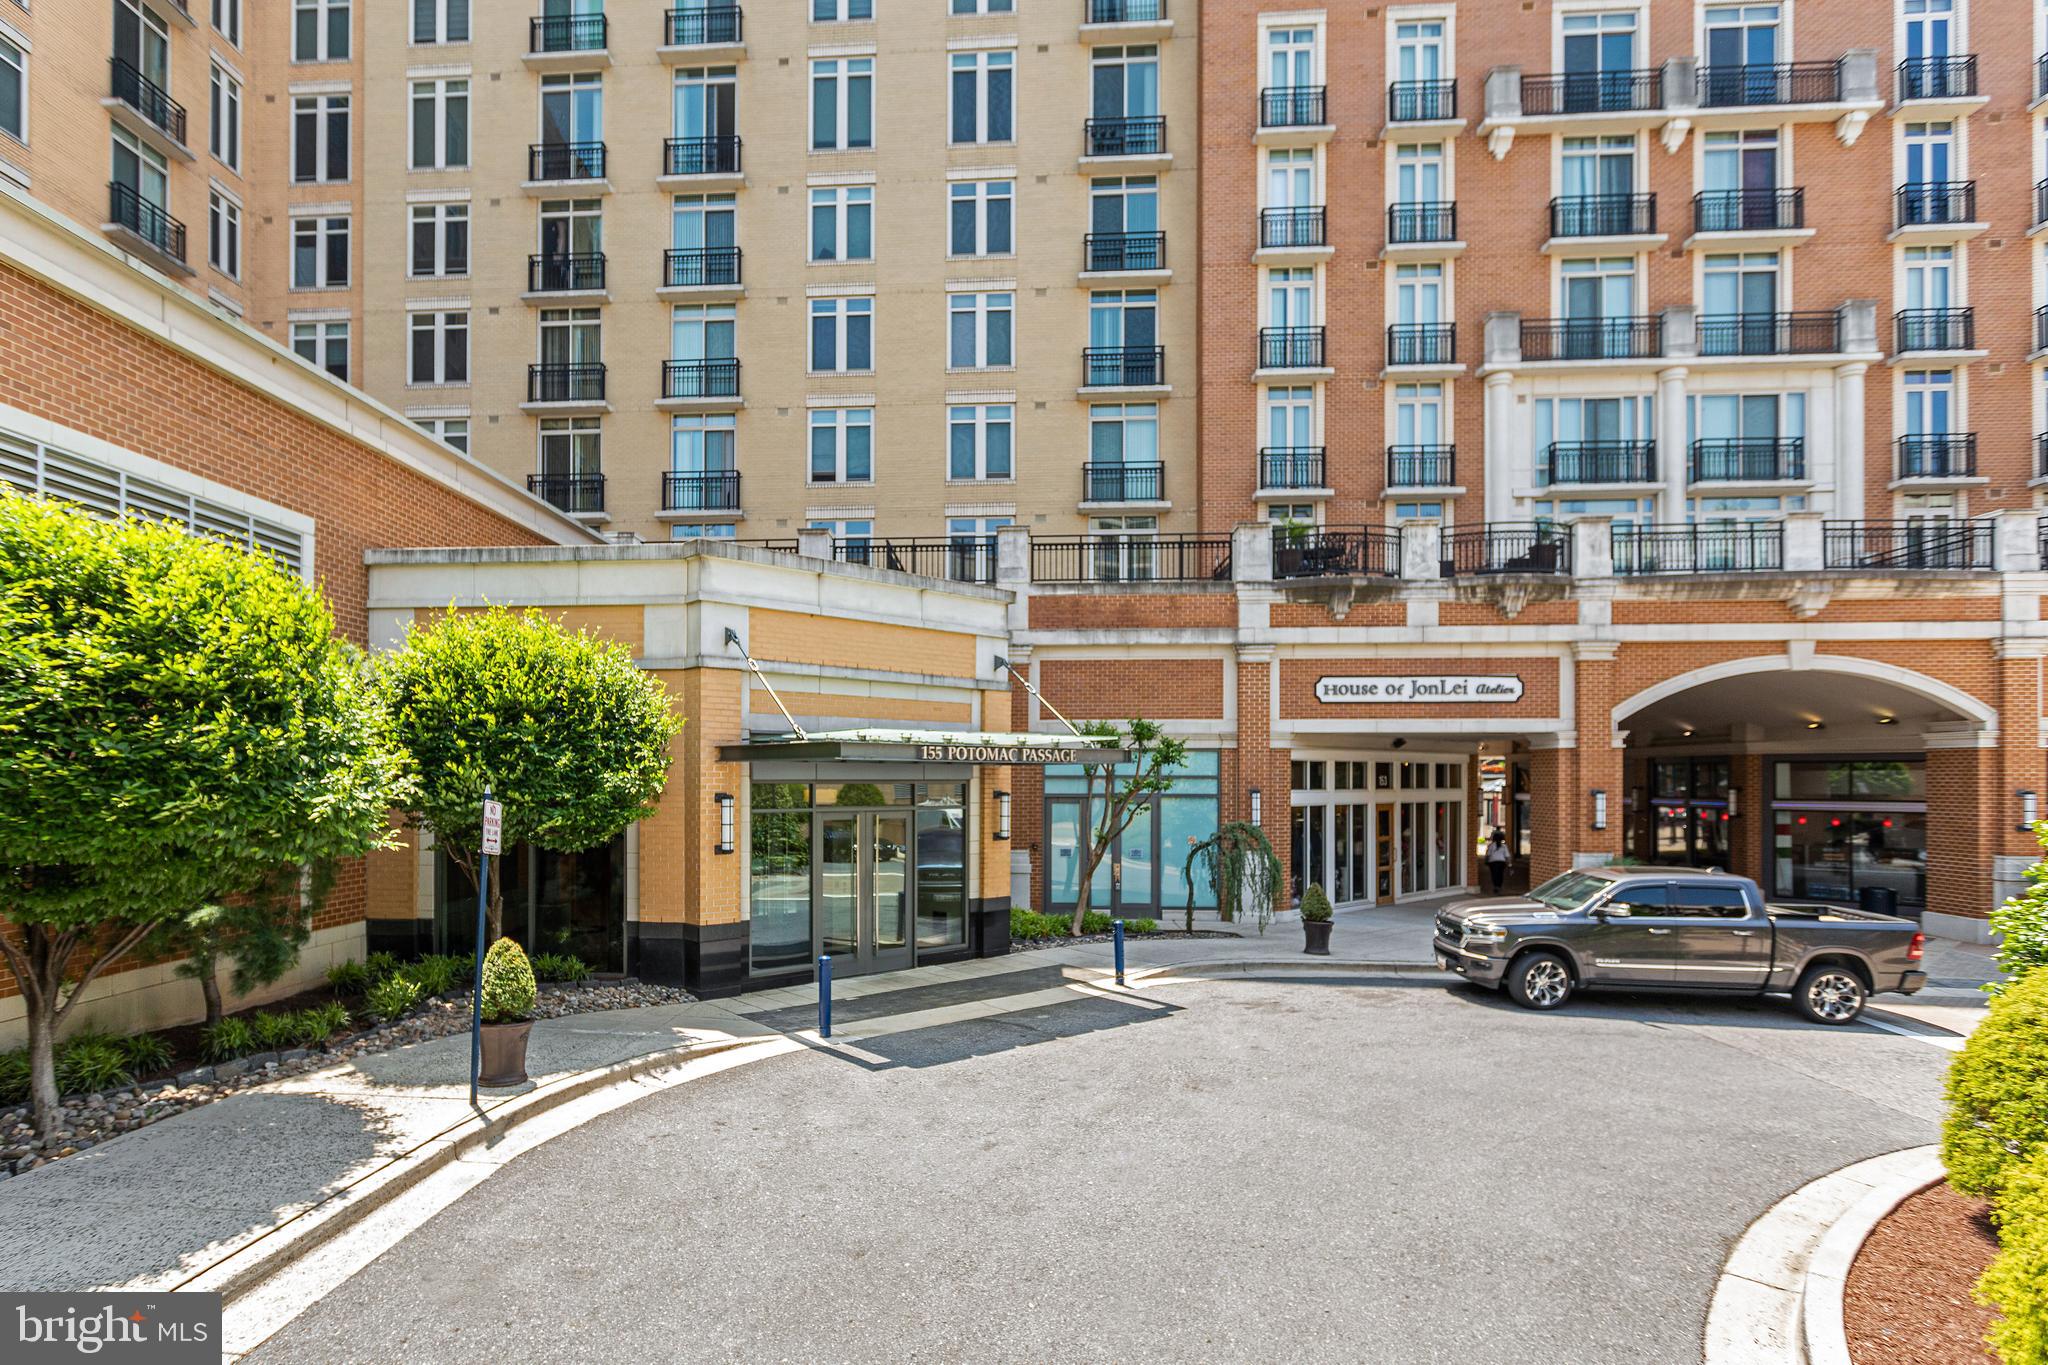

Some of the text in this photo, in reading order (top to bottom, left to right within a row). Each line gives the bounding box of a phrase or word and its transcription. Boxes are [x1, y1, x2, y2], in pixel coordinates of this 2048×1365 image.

[1323, 679, 1516, 699] House of JonLei Atelier
[921, 746, 1077, 762] 155 POTOMAC PASSAGE
